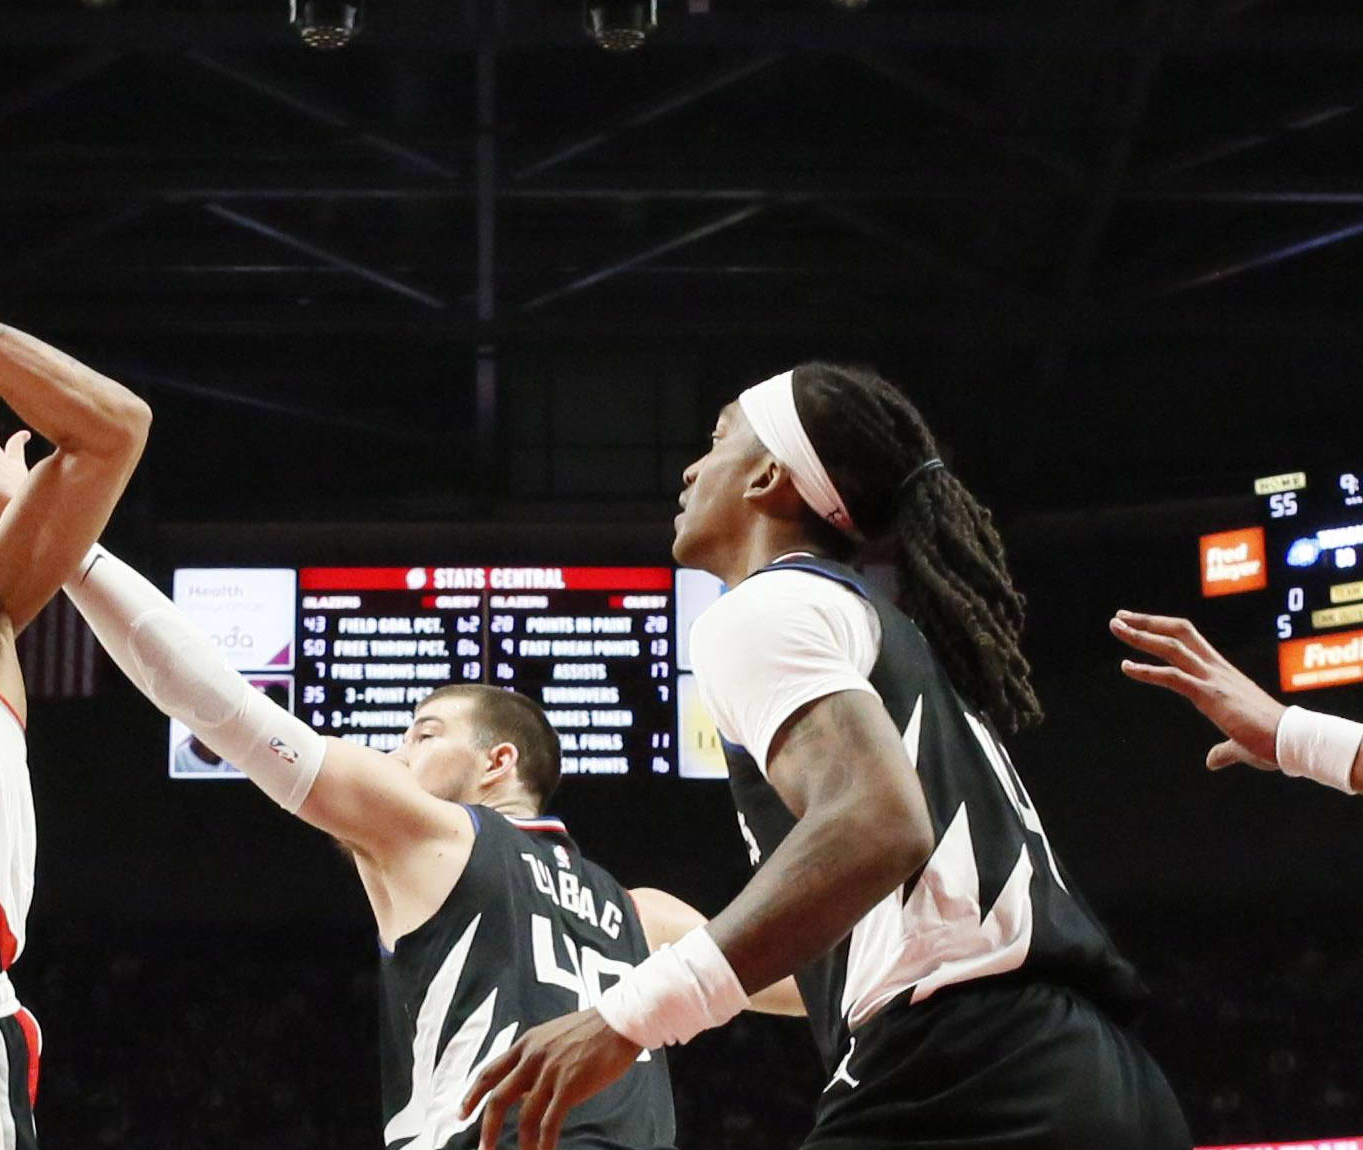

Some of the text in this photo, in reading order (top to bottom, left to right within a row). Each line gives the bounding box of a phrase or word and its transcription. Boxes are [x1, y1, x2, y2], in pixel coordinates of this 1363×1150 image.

[1269, 492, 1298, 518] 55
[1206, 542, 1248, 566] Fred
[433, 567, 566, 590] STATS CENTRAL
[1205, 560, 1261, 582] Meyer
[1287, 587, 1304, 611] 0
[303, 615, 326, 633] 43
[338, 617, 378, 634] FIELD
[526, 617, 574, 634] POINTS
[1276, 614, 1292, 639] 5
[303, 638, 326, 656] 50
[333, 640, 369, 657] FREE
[519, 640, 551, 657] FAST
[593, 640, 640, 657] POINTS
[315, 661, 326, 678] 7
[303, 685, 326, 704] 35
[542, 687, 620, 704] TURNOVERS
[312, 709, 325, 727] 6
